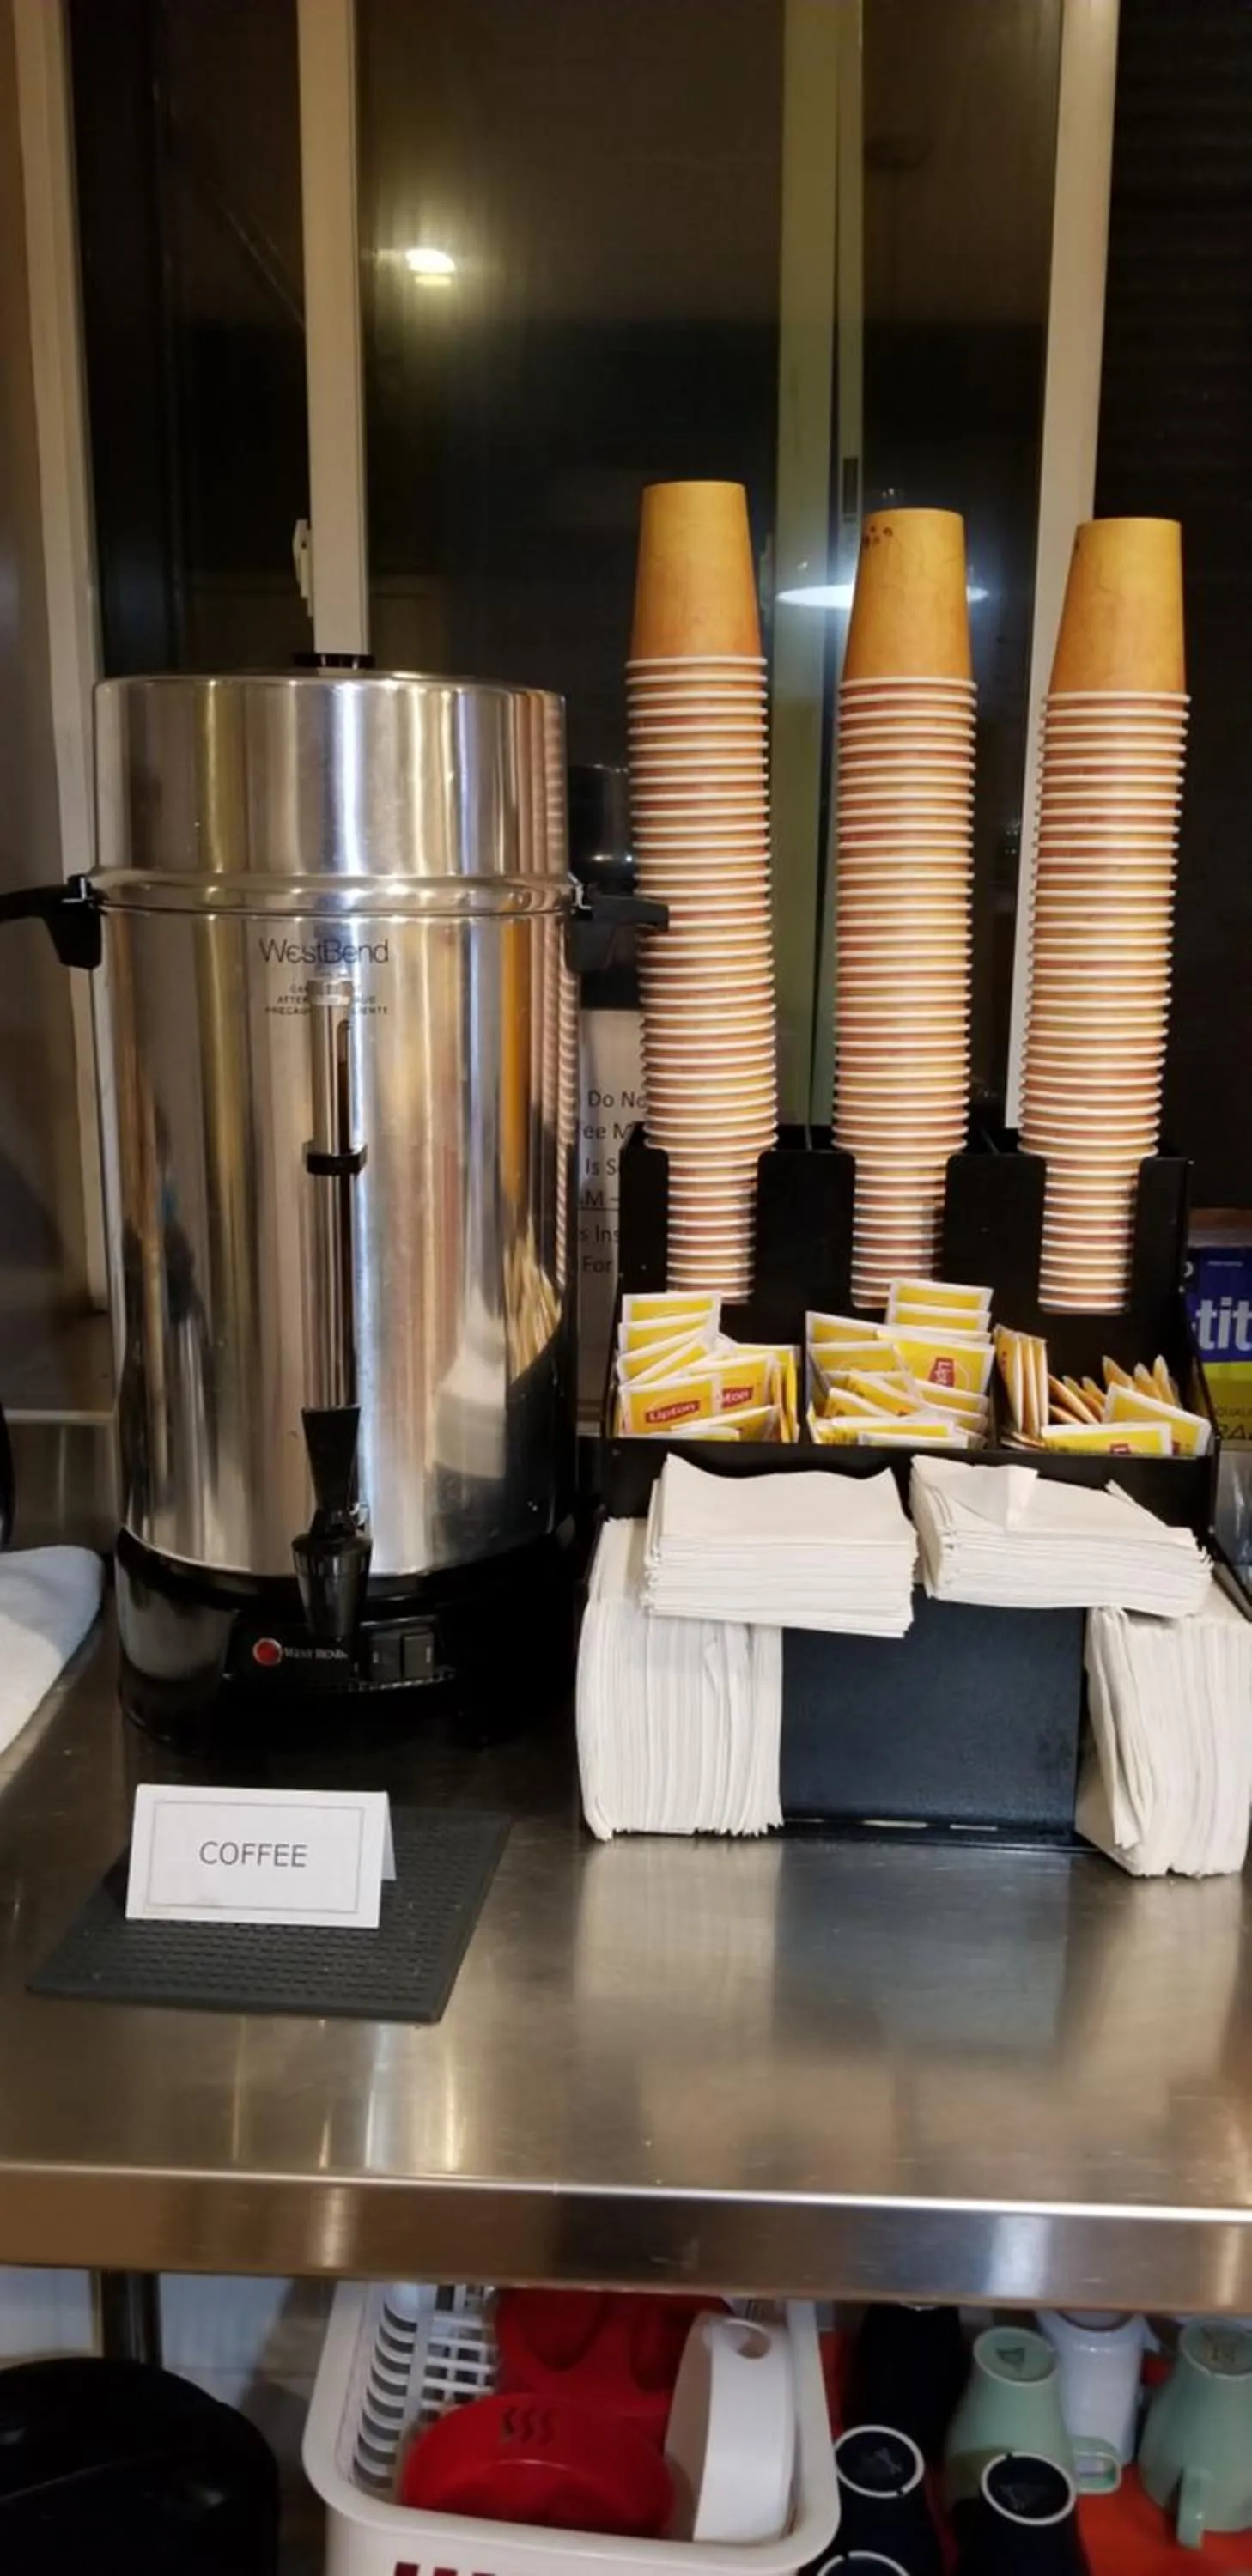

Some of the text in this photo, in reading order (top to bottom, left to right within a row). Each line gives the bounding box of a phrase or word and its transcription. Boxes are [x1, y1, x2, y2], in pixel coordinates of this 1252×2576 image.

[259, 938, 389, 964] WestBend
[587, 1091, 646, 1108] Do No
[582, 1124, 606, 1139] ee
[606, 1158, 618, 1176] S
[595, 1224, 619, 1242] Ins
[1191, 1297, 1252, 1351] tit
[647, 1401, 699, 1422] Lipton
[198, 1840, 308, 1868] COFFEE
